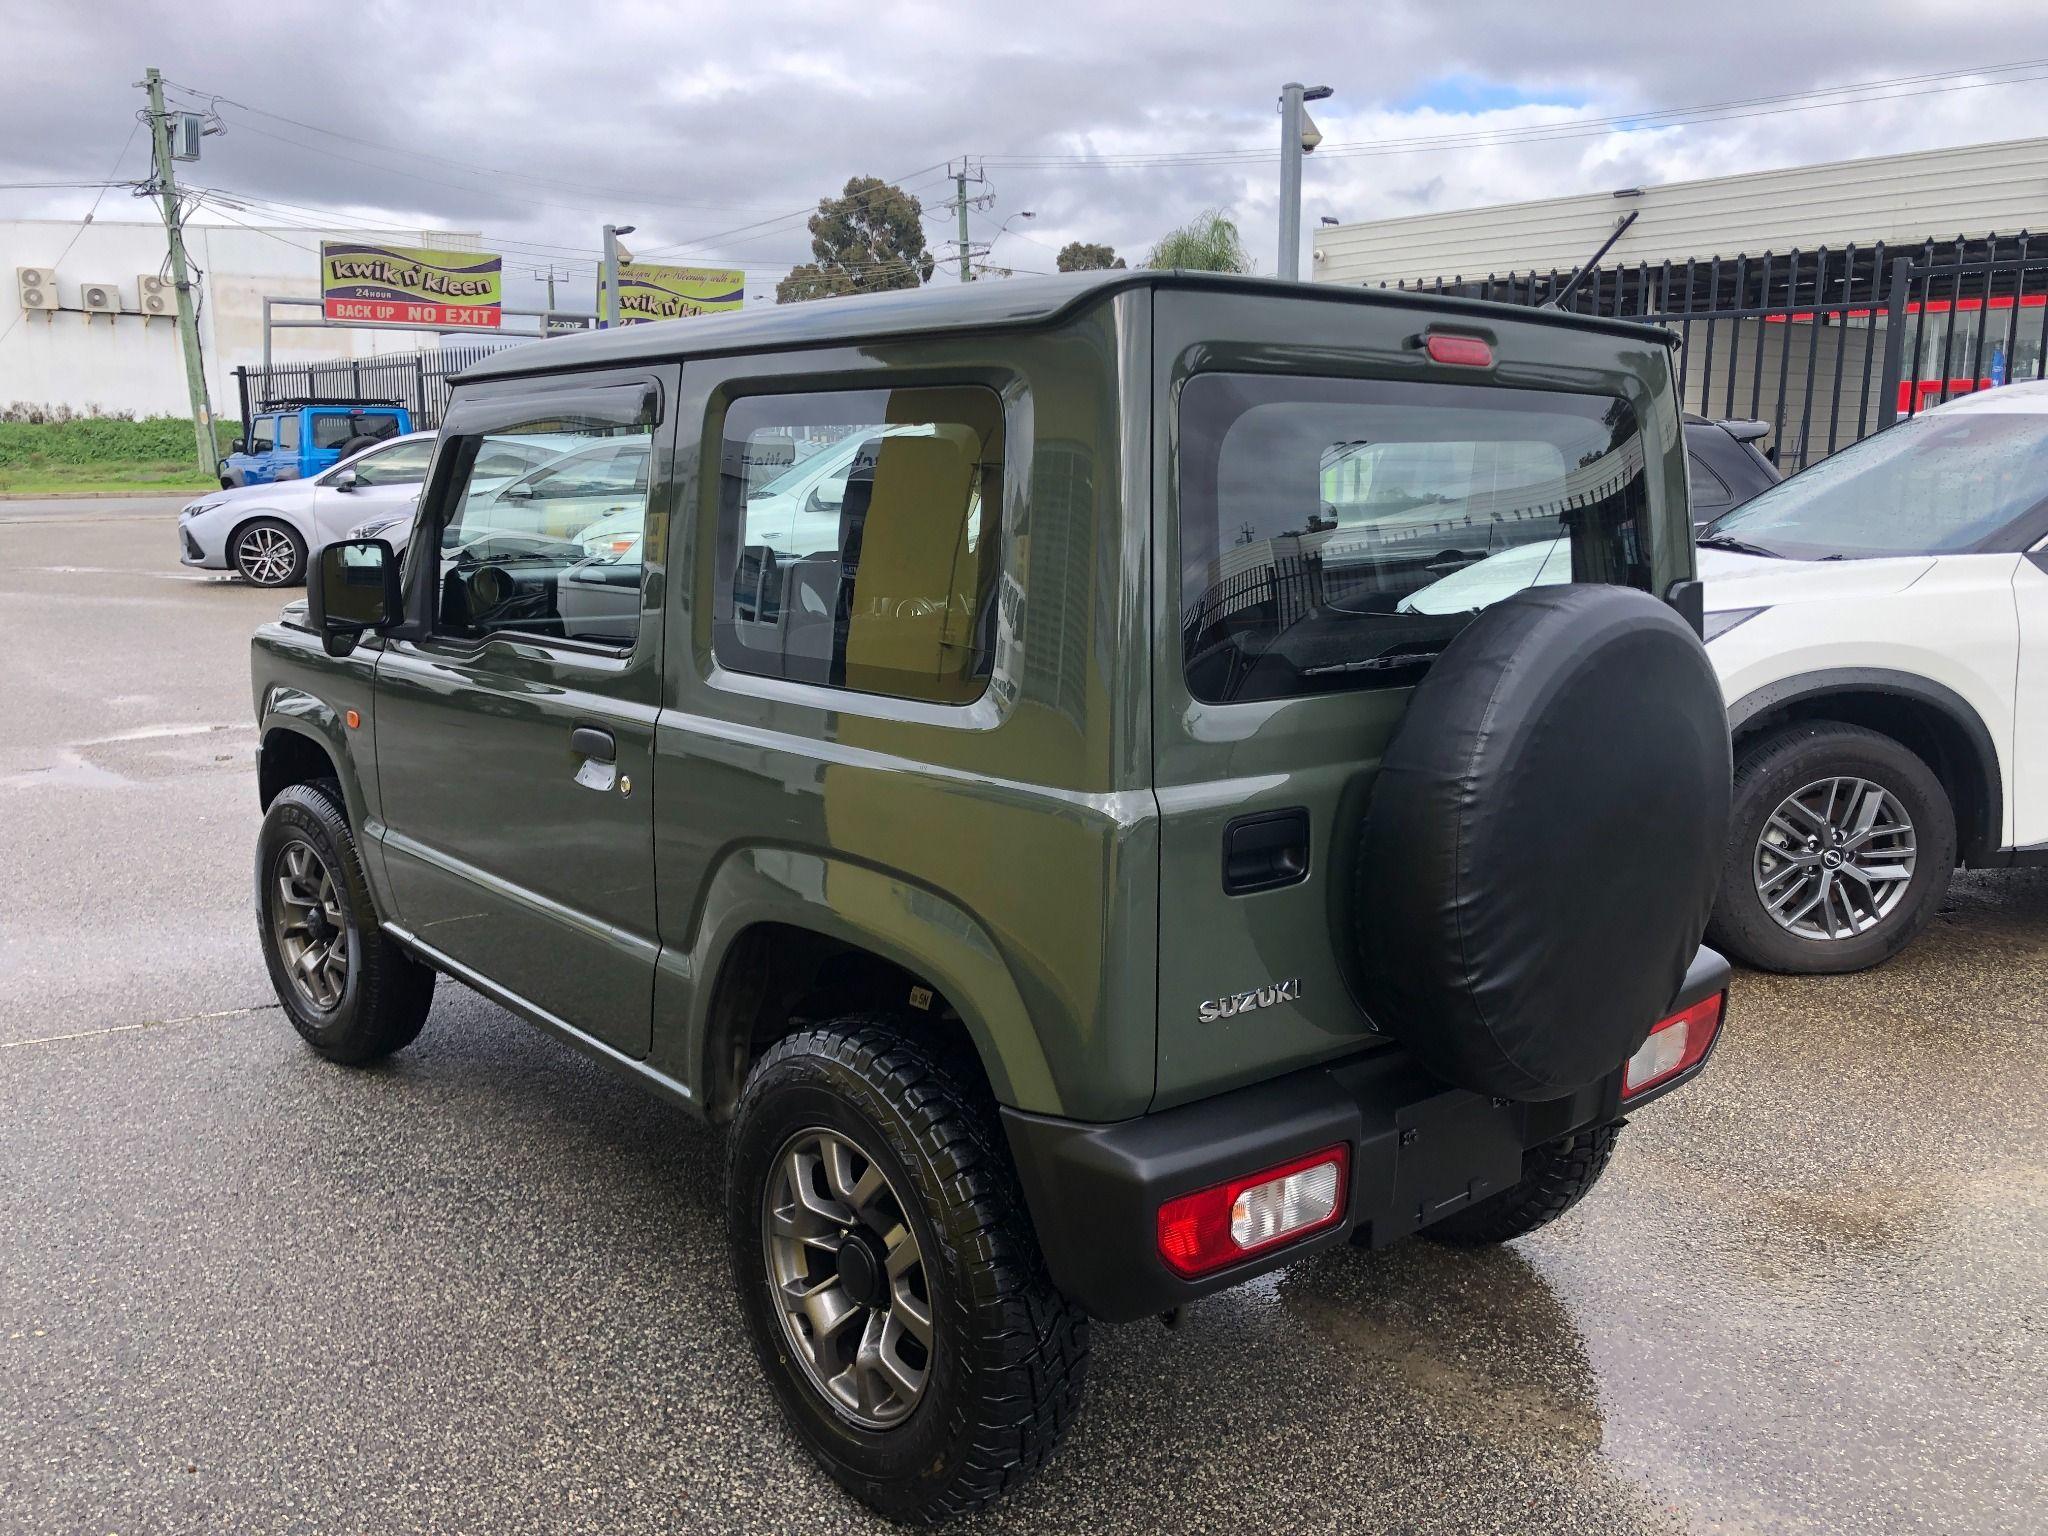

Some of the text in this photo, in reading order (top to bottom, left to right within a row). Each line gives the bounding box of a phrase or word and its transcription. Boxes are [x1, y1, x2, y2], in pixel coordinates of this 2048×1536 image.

[331, 260, 401, 285] kwik
[422, 272, 493, 297] kleen
[336, 303, 492, 325] BACK UP NO EXIT
[619, 293, 660, 315] wik
[1198, 978, 1302, 1022] SUZUKI
